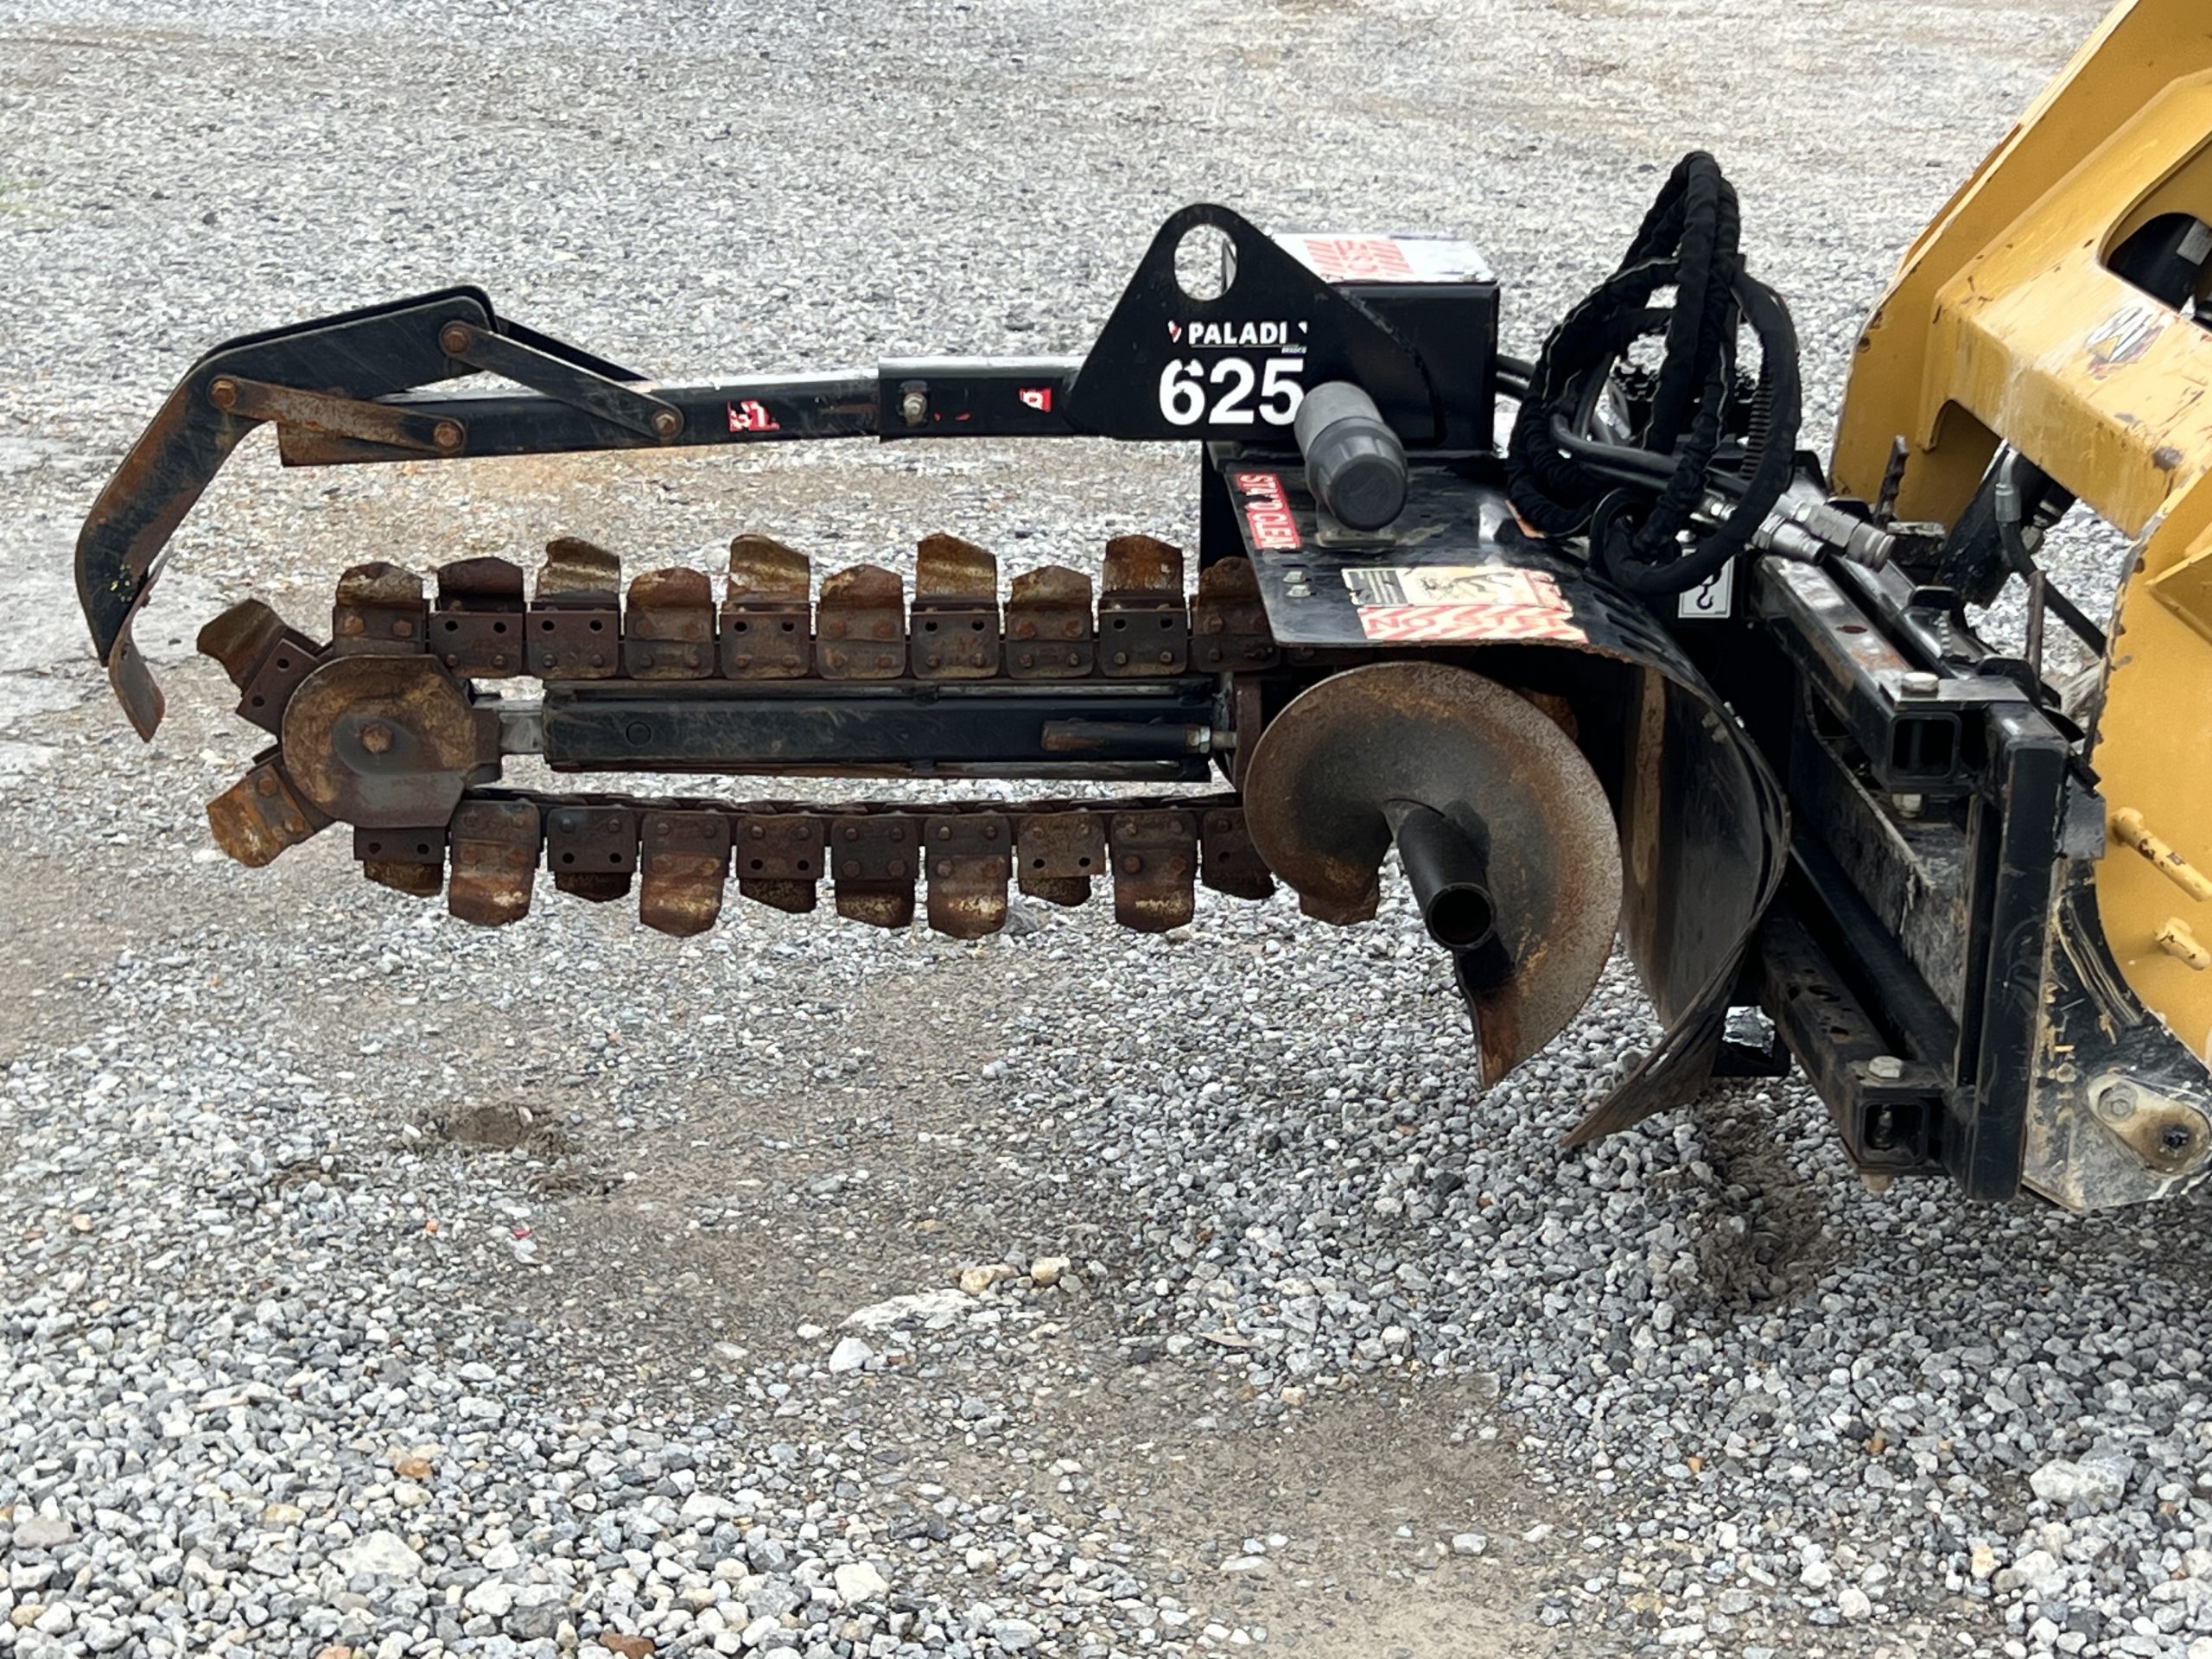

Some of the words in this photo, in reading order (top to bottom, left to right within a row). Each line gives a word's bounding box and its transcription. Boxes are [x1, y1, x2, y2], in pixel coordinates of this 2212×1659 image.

[1188, 321, 1307, 345] PALADI
[1159, 357, 1305, 425] 625
[1239, 474, 1284, 512] STAD
[1369, 616, 1437, 630] NO
